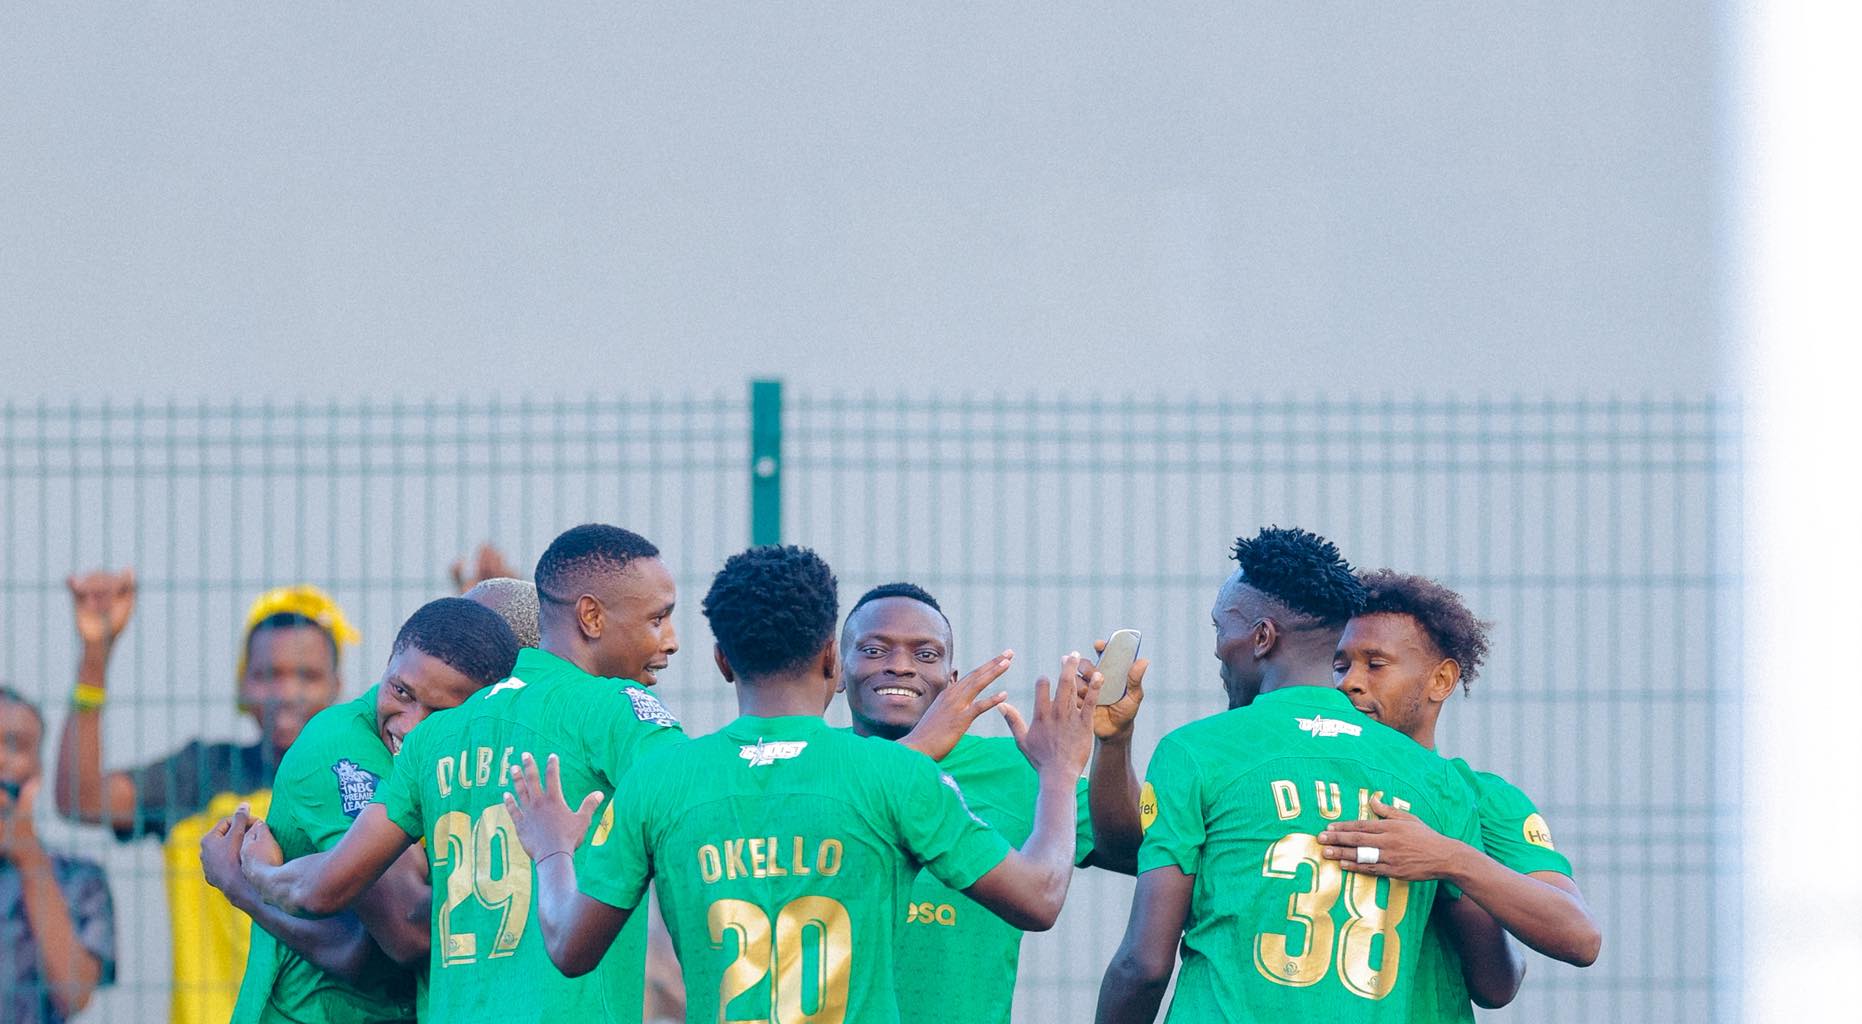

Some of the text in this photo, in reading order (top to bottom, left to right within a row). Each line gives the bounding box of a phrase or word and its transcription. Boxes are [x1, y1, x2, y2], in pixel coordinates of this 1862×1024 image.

[347, 782, 374, 794] NBC
[344, 792, 375, 802] PREMIE
[344, 801, 369, 813] LEAG
[1140, 801, 1155, 815] ier
[697, 836, 844, 885] OKELLO
[433, 803, 533, 969] 29
[1253, 832, 1410, 1000] 38
